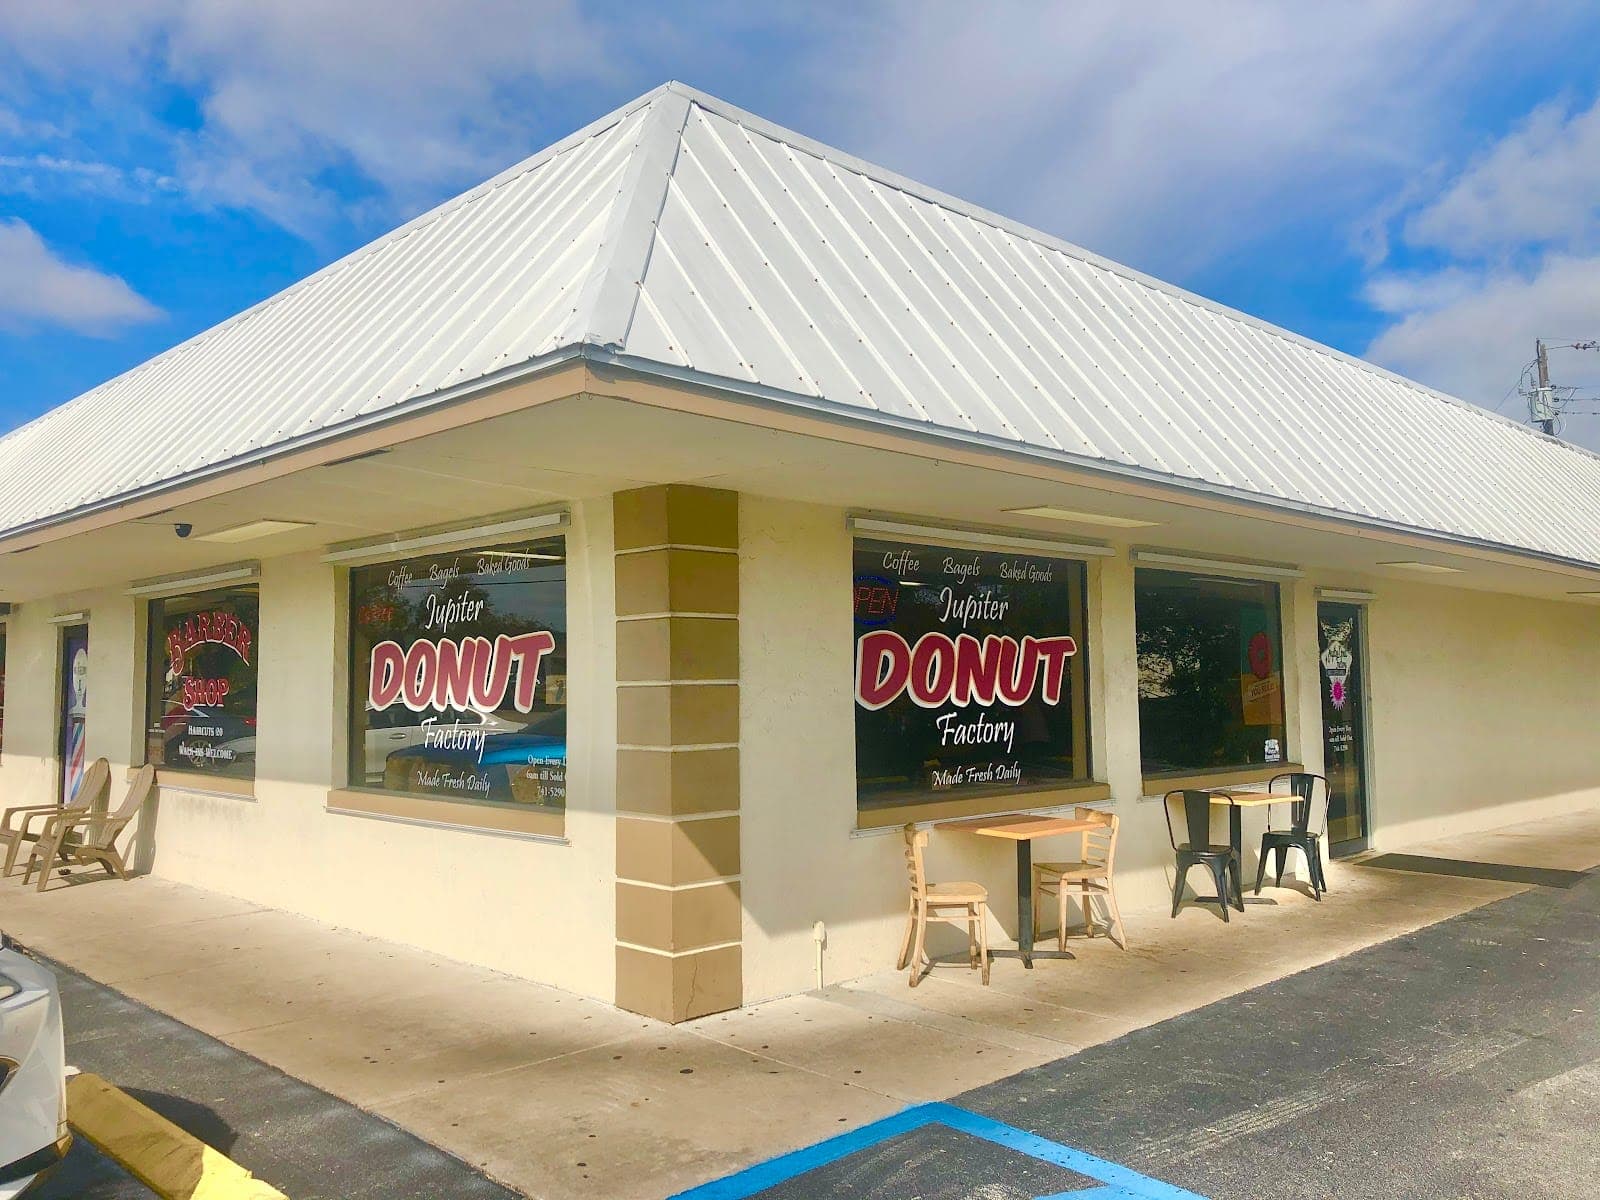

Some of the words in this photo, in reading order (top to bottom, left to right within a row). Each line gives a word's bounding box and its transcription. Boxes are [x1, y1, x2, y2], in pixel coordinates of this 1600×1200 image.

[387, 565, 413, 590] Coffee
[429, 557, 461, 589] Bagels
[476, 553, 503, 576] Baked
[504, 548, 530, 574] Goods
[882, 550, 920, 576] Coffee
[943, 556, 981, 584] Bagels
[1000, 560, 1027, 580] Baked
[1028, 563, 1053, 583] Goods
[425, 590, 484, 634] Jupiter
[854, 586, 899, 614] PEN
[939, 586, 1009, 629] Jupiter
[167, 610, 252, 676] BARBER
[368, 630, 556, 714] DONUT
[855, 629, 1078, 712] DONUT
[182, 676, 230, 711] SHOP
[421, 716, 488, 765] Factory
[936, 711, 1016, 754] Factory
[417, 769, 440, 787] Made
[441, 771, 465, 789] Fresh
[466, 772, 491, 799] Daily
[549, 770, 564, 782] Sold
[933, 766, 963, 786] Made
[965, 762, 993, 783] Fresh
[995, 761, 1021, 785] Daily
